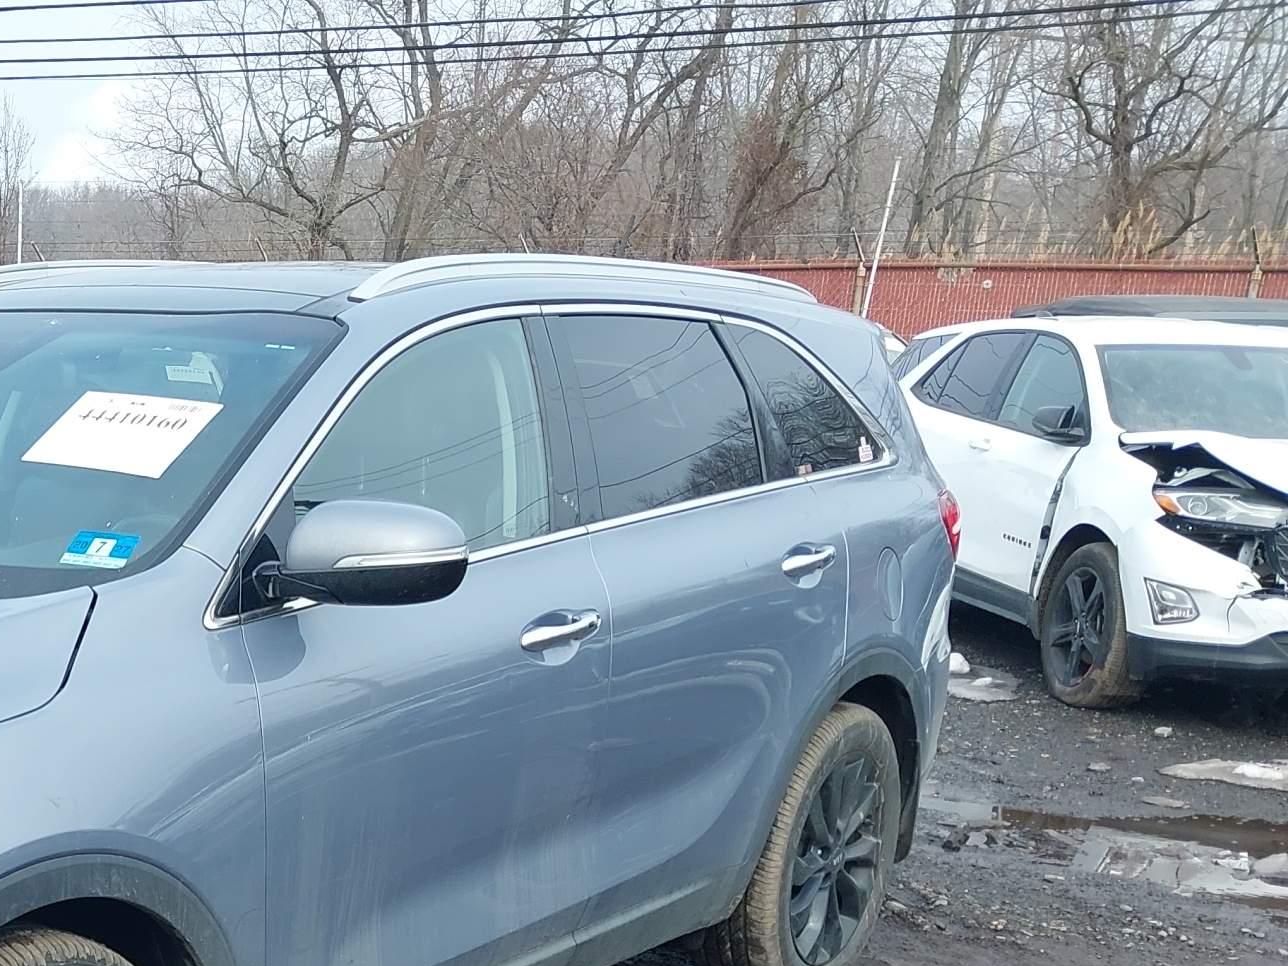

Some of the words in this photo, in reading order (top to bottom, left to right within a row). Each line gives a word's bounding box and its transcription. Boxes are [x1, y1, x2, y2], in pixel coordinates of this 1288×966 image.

[79, 408, 188, 430] 44410160
[72, 540, 89, 550] 20
[95, 541, 108, 553] 7
